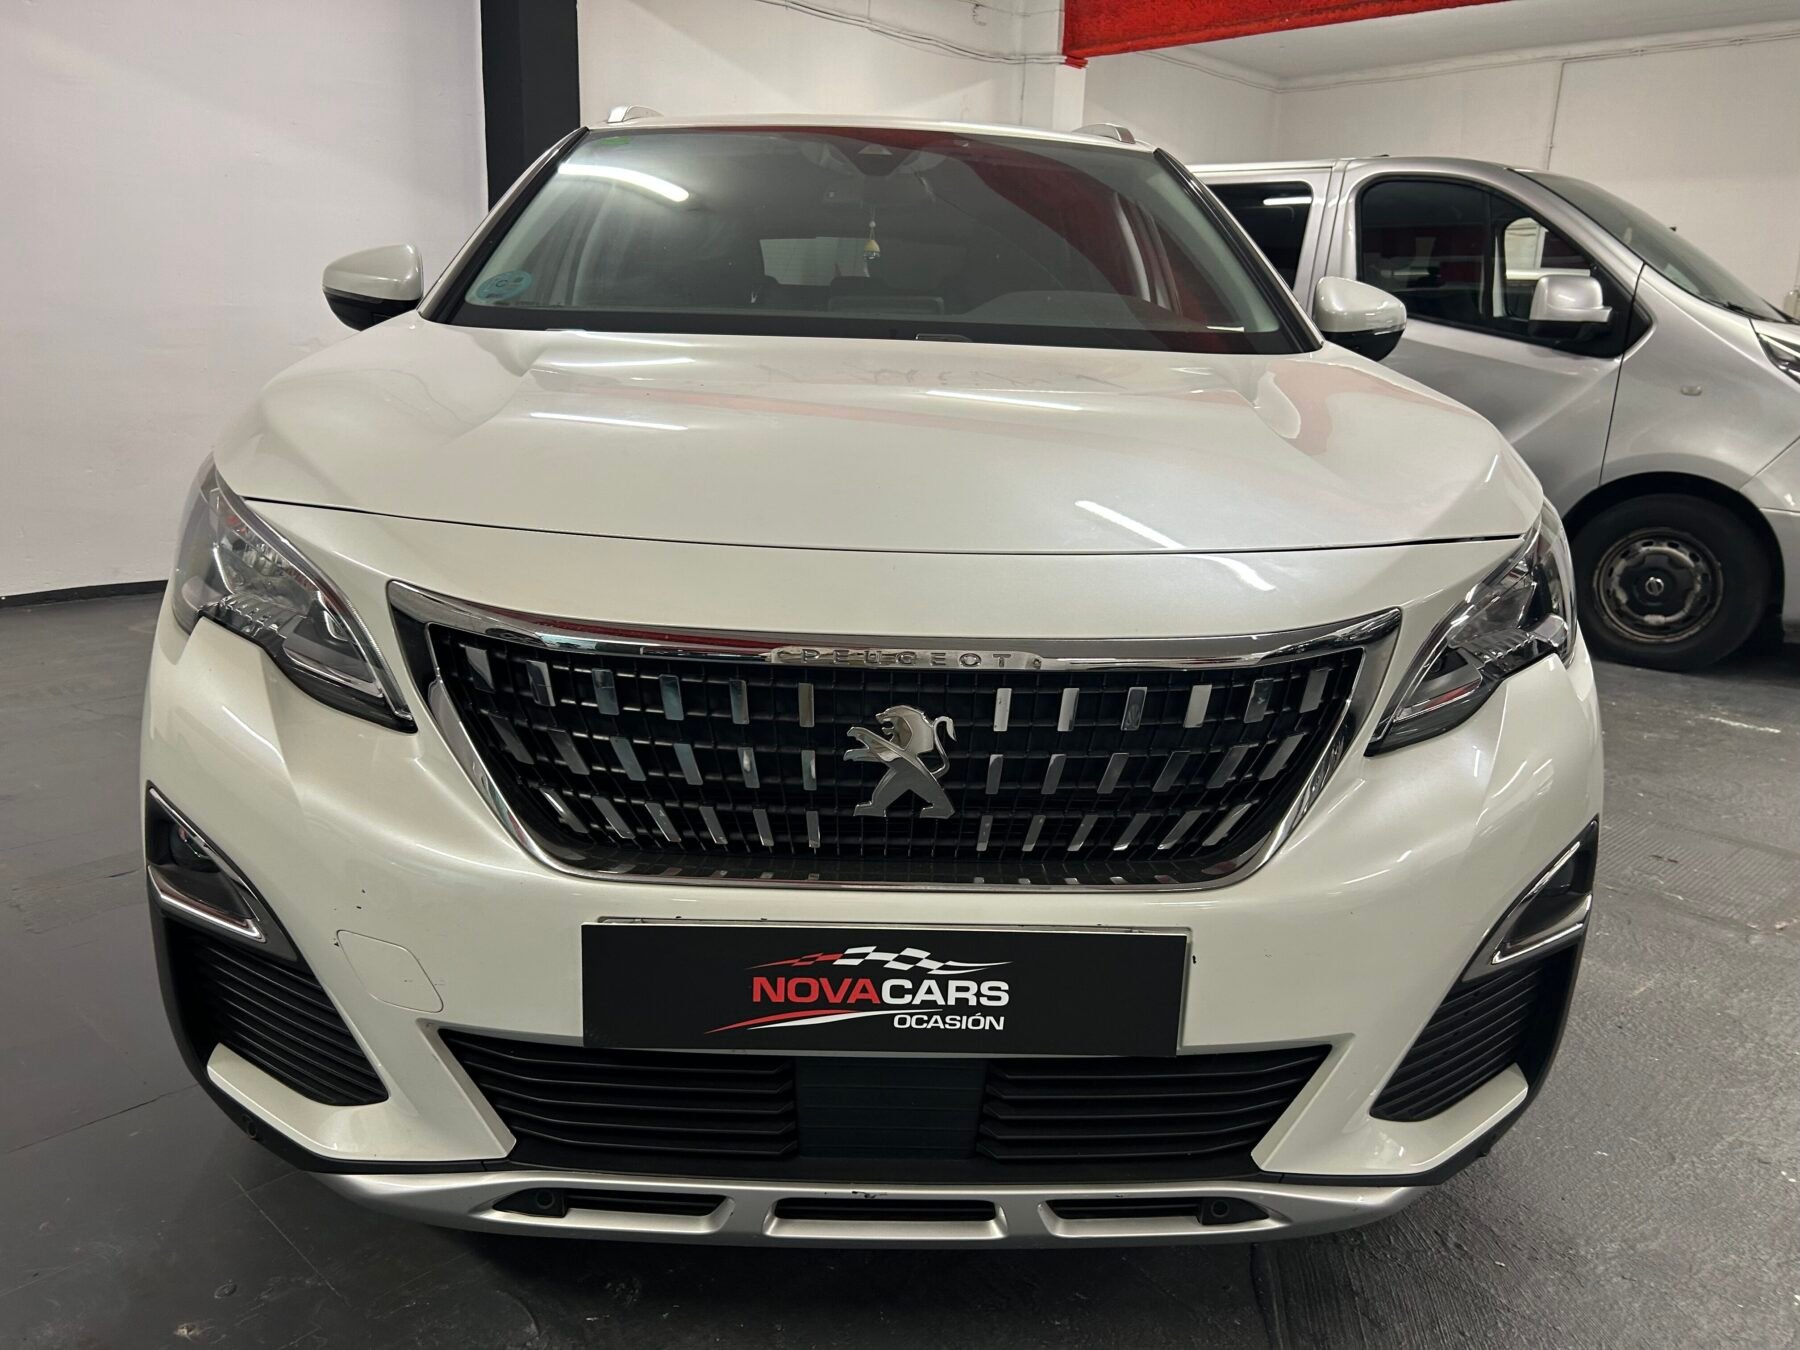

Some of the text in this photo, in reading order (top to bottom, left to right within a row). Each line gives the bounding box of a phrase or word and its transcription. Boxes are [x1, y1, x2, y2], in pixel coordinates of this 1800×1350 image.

[802, 649, 1011, 668] PEUGEOT
[752, 977, 1009, 1006] NOVACARS
[893, 1012, 1005, 1030] OCASIÓN
